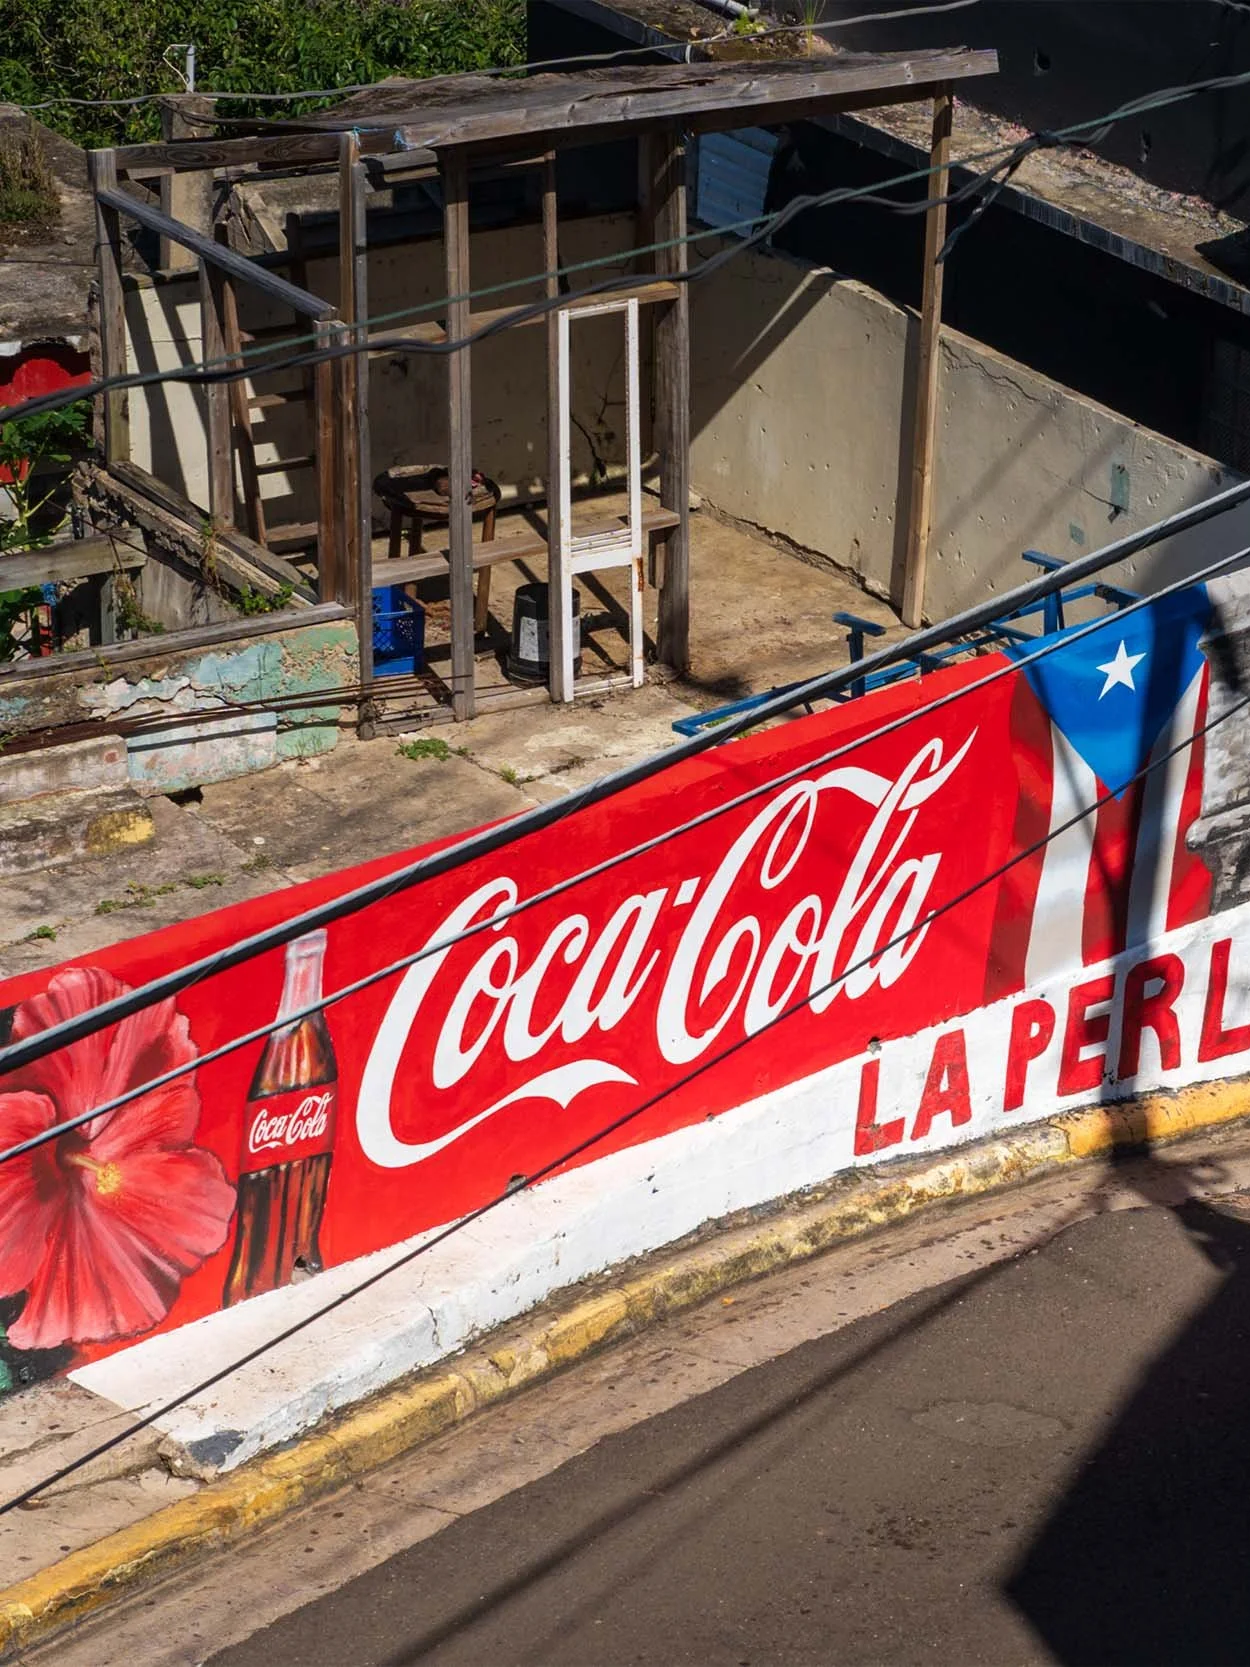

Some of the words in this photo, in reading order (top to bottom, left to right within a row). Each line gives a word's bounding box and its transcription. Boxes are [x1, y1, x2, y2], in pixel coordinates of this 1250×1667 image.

[355, 726, 980, 1168] Coca-Cola
[248, 1092, 334, 1153] Coca-Cola
[854, 1028, 972, 1157] LA
